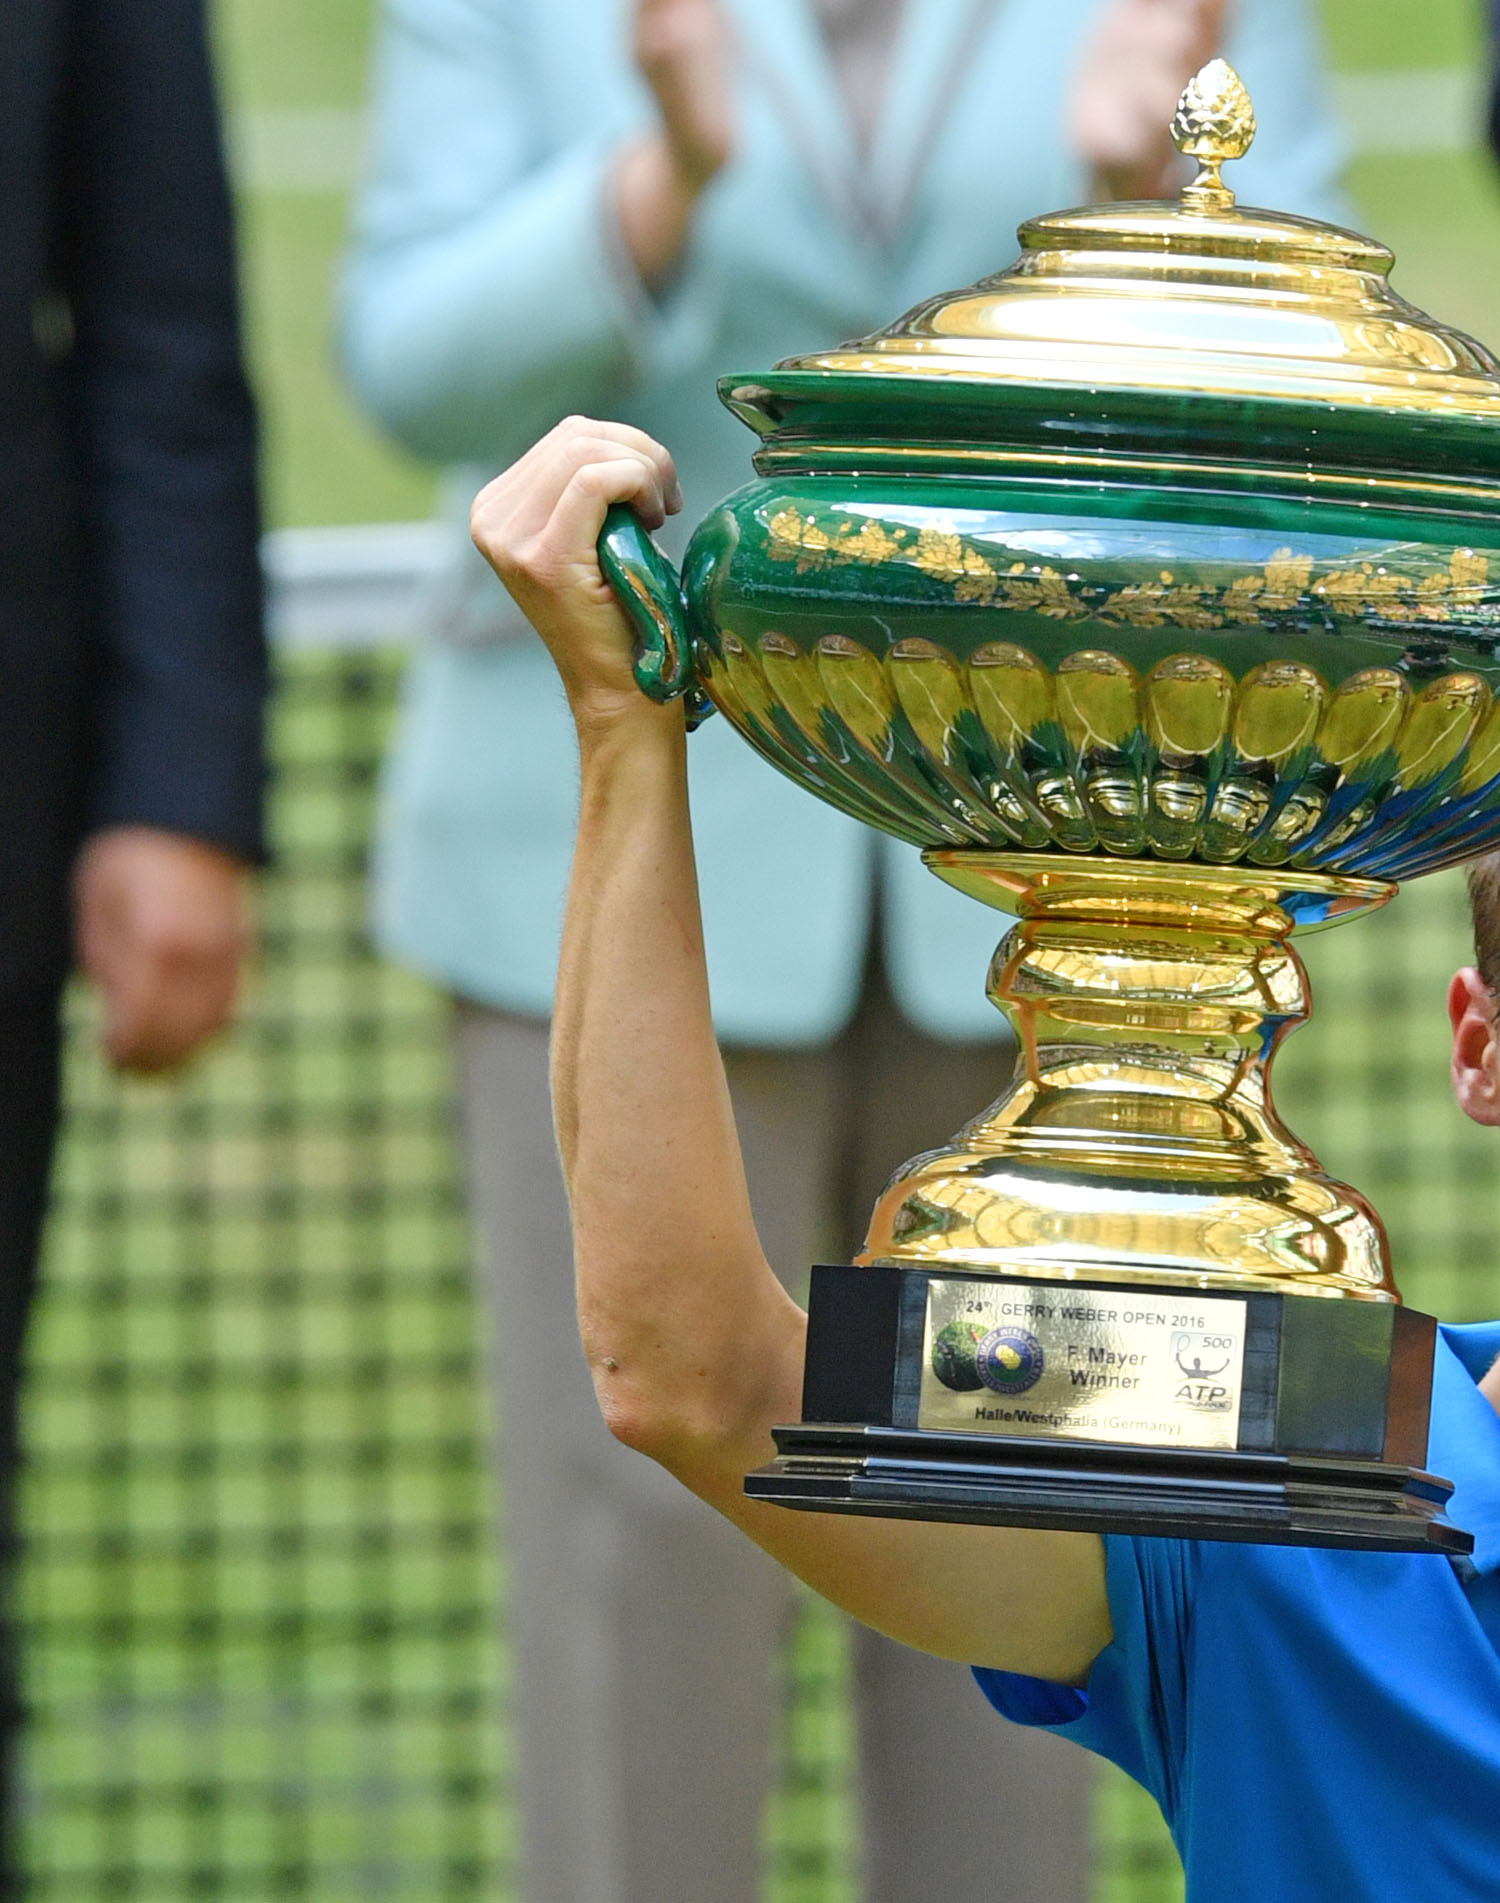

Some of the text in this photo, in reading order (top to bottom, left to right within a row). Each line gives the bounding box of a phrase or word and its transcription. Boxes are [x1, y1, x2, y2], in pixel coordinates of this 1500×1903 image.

[1001, 1302, 1056, 1319] GERRY
[1061, 1306, 1117, 1323] WEBER
[1123, 1311, 1166, 1326] OPEN
[1171, 1315, 1205, 1329] 2016
[1202, 1336, 1233, 1349] 500
[1067, 1346, 1081, 1362] F.
[1088, 1347, 1147, 1370] Mayer
[1070, 1370, 1140, 1389] Winner
[1175, 1385, 1227, 1402] ATP
[975, 1407, 1182, 1436] Halle/Westphalia (Germany)
